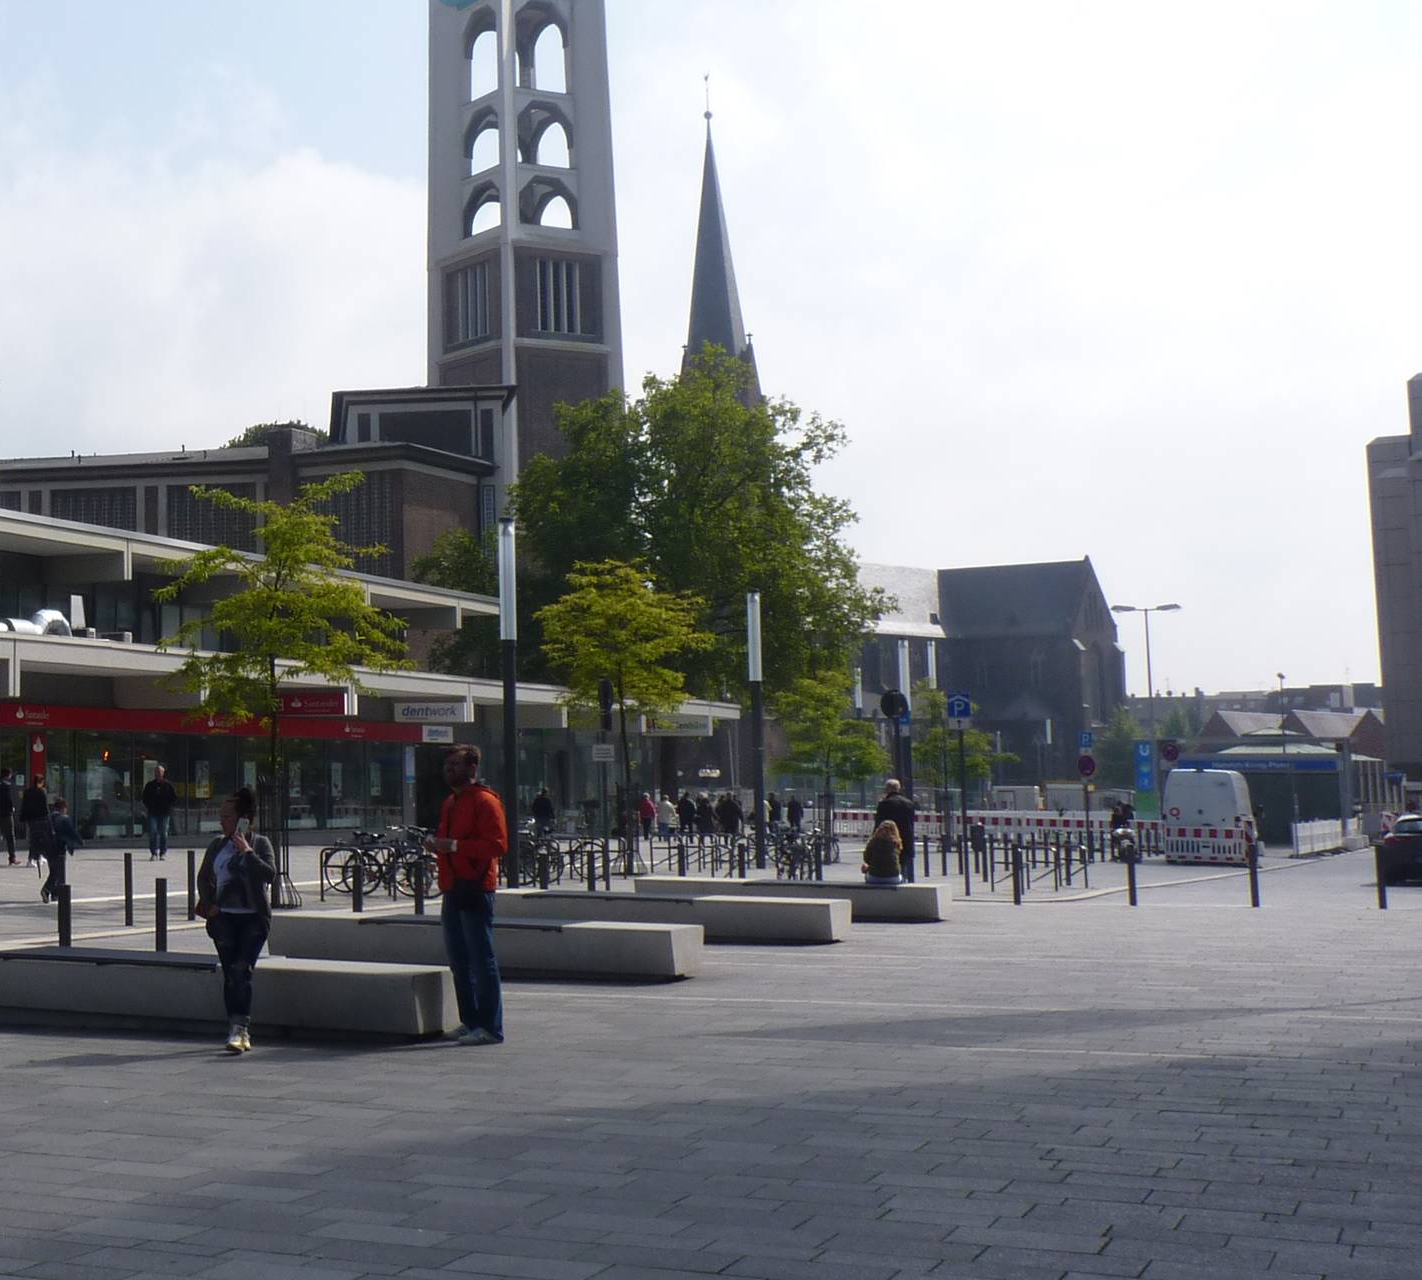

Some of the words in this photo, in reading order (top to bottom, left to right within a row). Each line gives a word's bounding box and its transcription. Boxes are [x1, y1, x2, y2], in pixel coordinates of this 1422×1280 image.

[401, 705, 457, 717] dentwork
[954, 701, 965, 718] P
[1139, 743, 1150, 757] U
